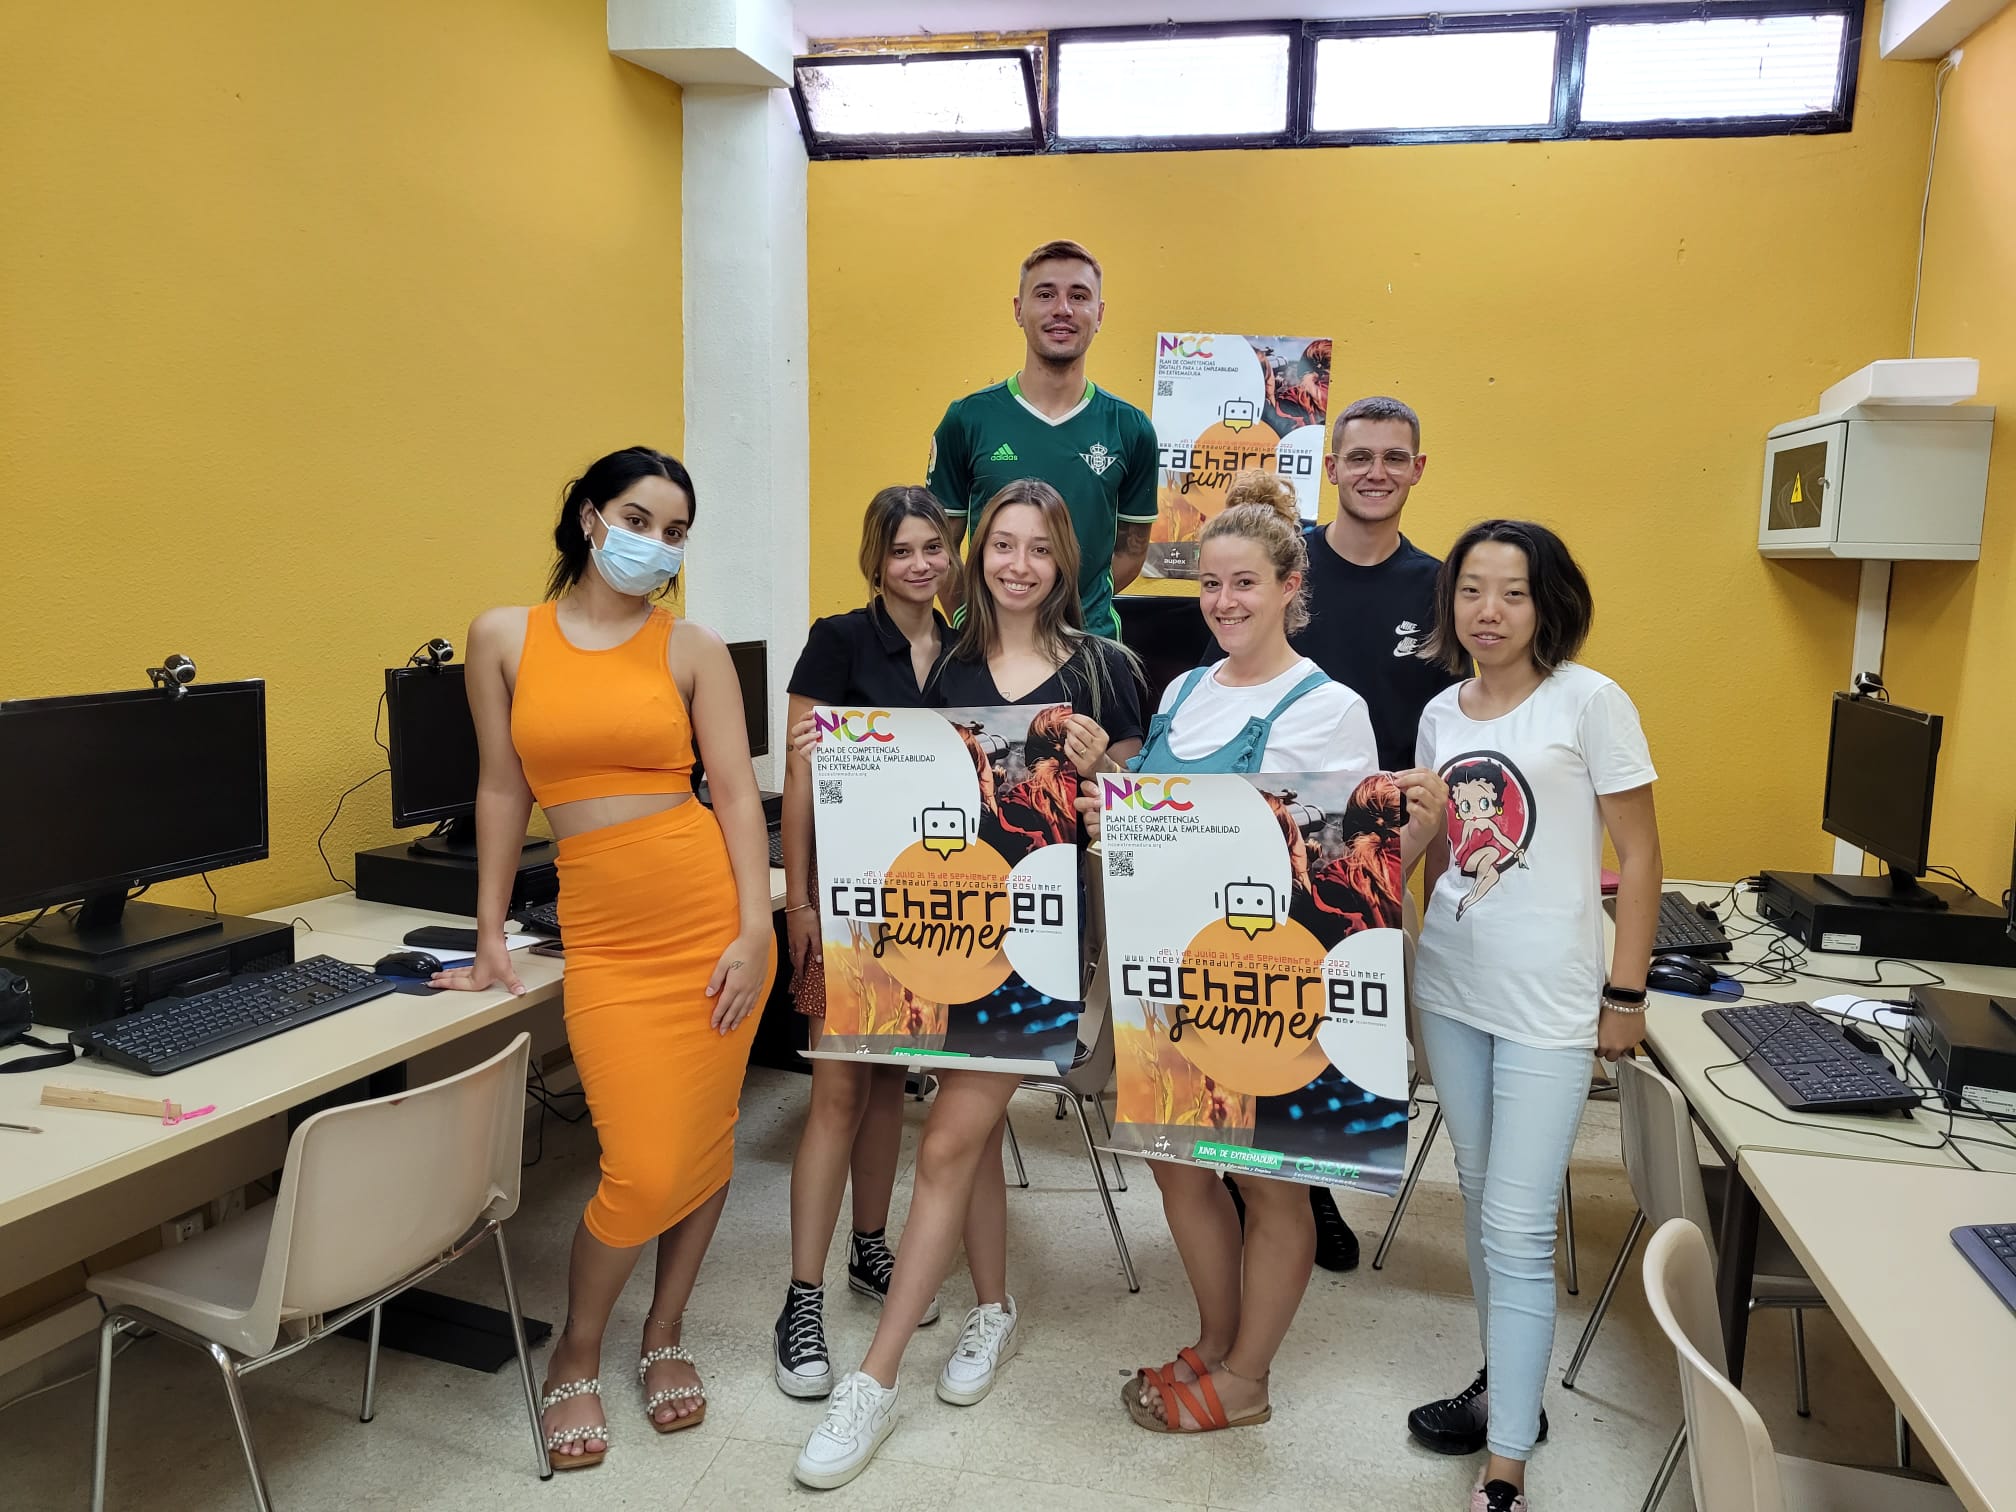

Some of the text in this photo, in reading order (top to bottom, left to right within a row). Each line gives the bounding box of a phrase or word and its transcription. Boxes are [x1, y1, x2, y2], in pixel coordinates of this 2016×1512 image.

[1160, 335, 1214, 358] NCC
[1181, 471, 1233, 494] sum
[1400, 620, 1418, 631] NIKE
[814, 710, 895, 742] NCC
[829, 763, 880, 771] EXTREMADURA
[1102, 776, 1195, 811] NCC
[1106, 815, 1200, 823] PLAN DE COMPETENCIAS
[1106, 824, 1143, 832] DIGITALES
[1181, 825, 1240, 834] EMPLEABILIDAD
[1120, 833, 1177, 841] EXTREMADURA
[831, 886, 1063, 926] cacharreo
[873, 921, 1016, 958] summer
[1328, 960, 1350, 968] 2022
[1122, 964, 1388, 1018] cacharreo
[1169, 1003, 1333, 1047] summer
[1198, 1146, 1278, 1166] JUNTA DE EXTREMADURA
[1316, 1161, 1360, 1179] SEXPE
